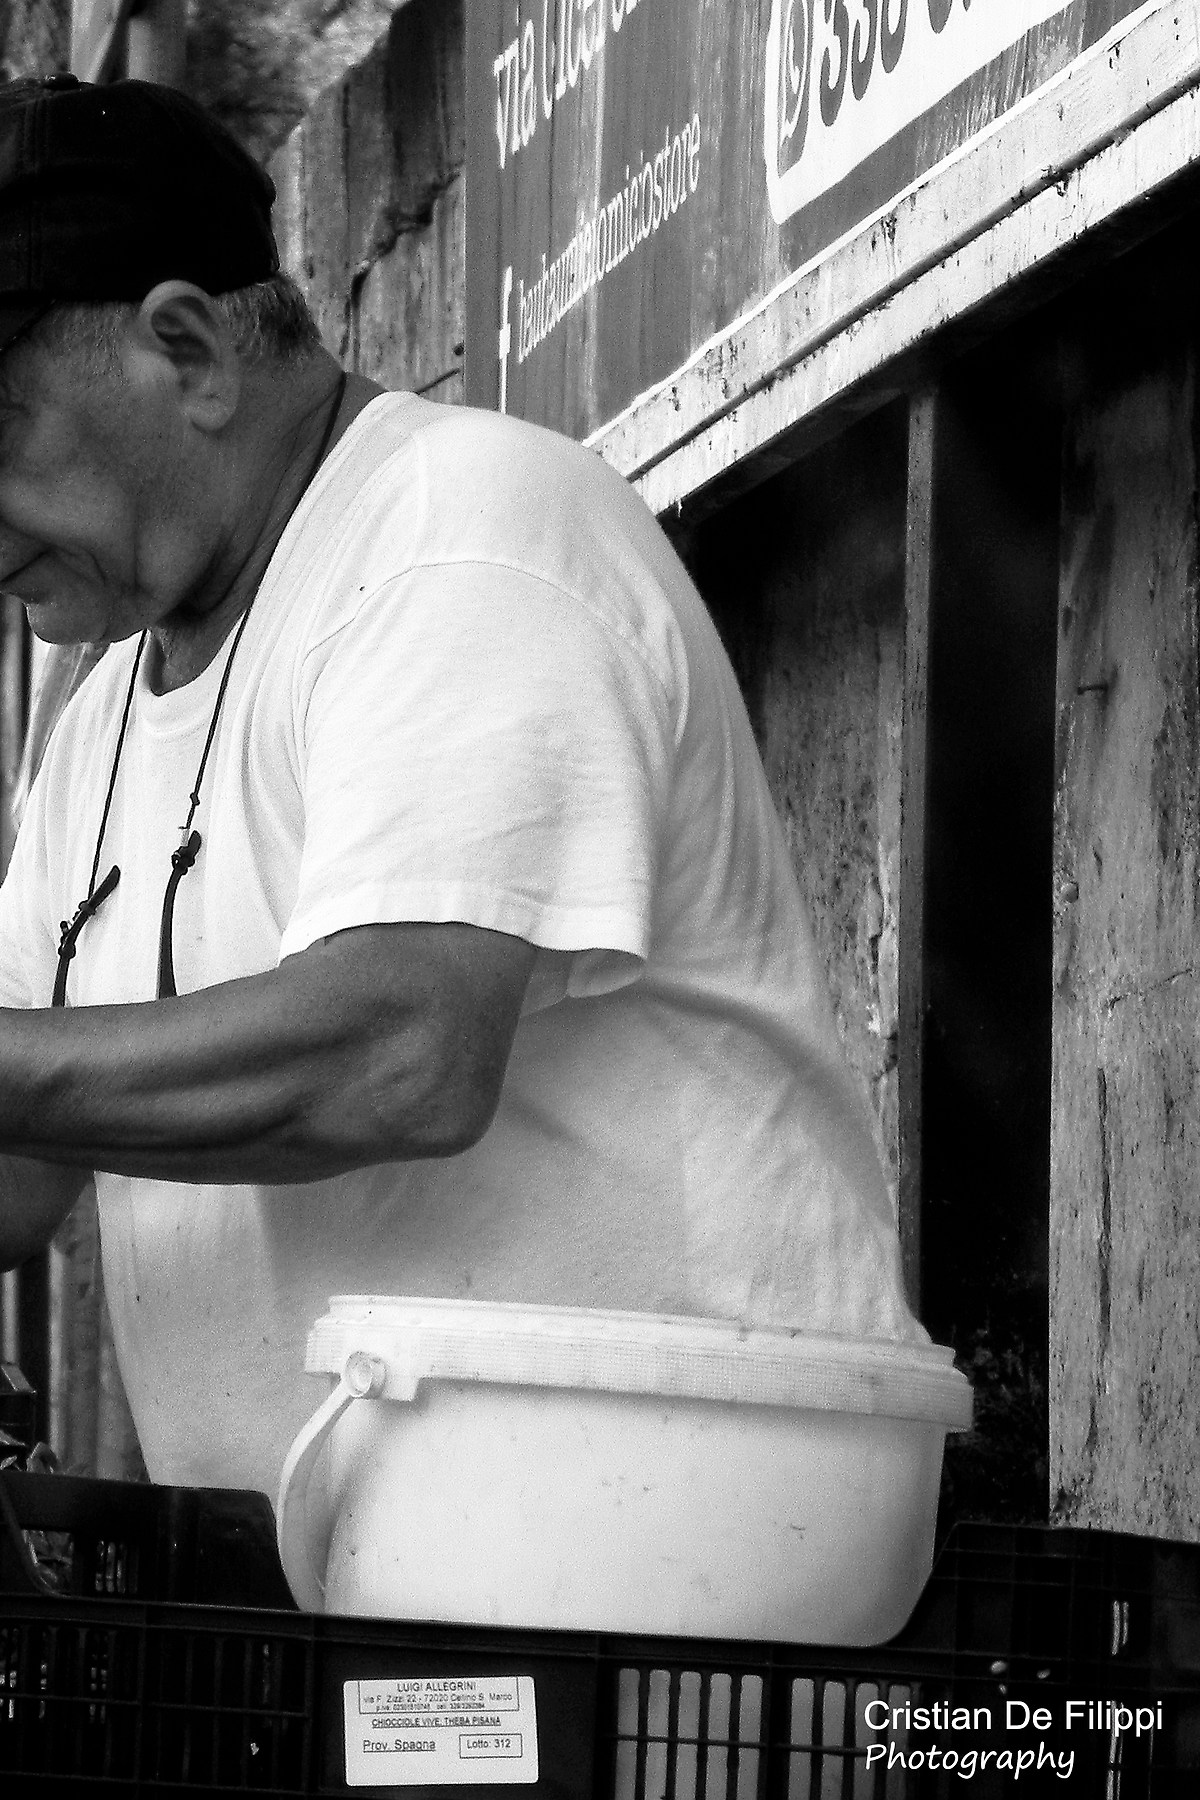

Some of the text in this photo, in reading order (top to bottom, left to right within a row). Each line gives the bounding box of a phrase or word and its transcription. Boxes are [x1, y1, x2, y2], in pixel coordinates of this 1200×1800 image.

[397, 1680, 477, 1693] LUIGI ALLEGRINI
[371, 1717, 420, 1728] CHIOCCIOLE
[394, 1738, 437, 1751] Spagna
[494, 1738, 511, 1749] 312
